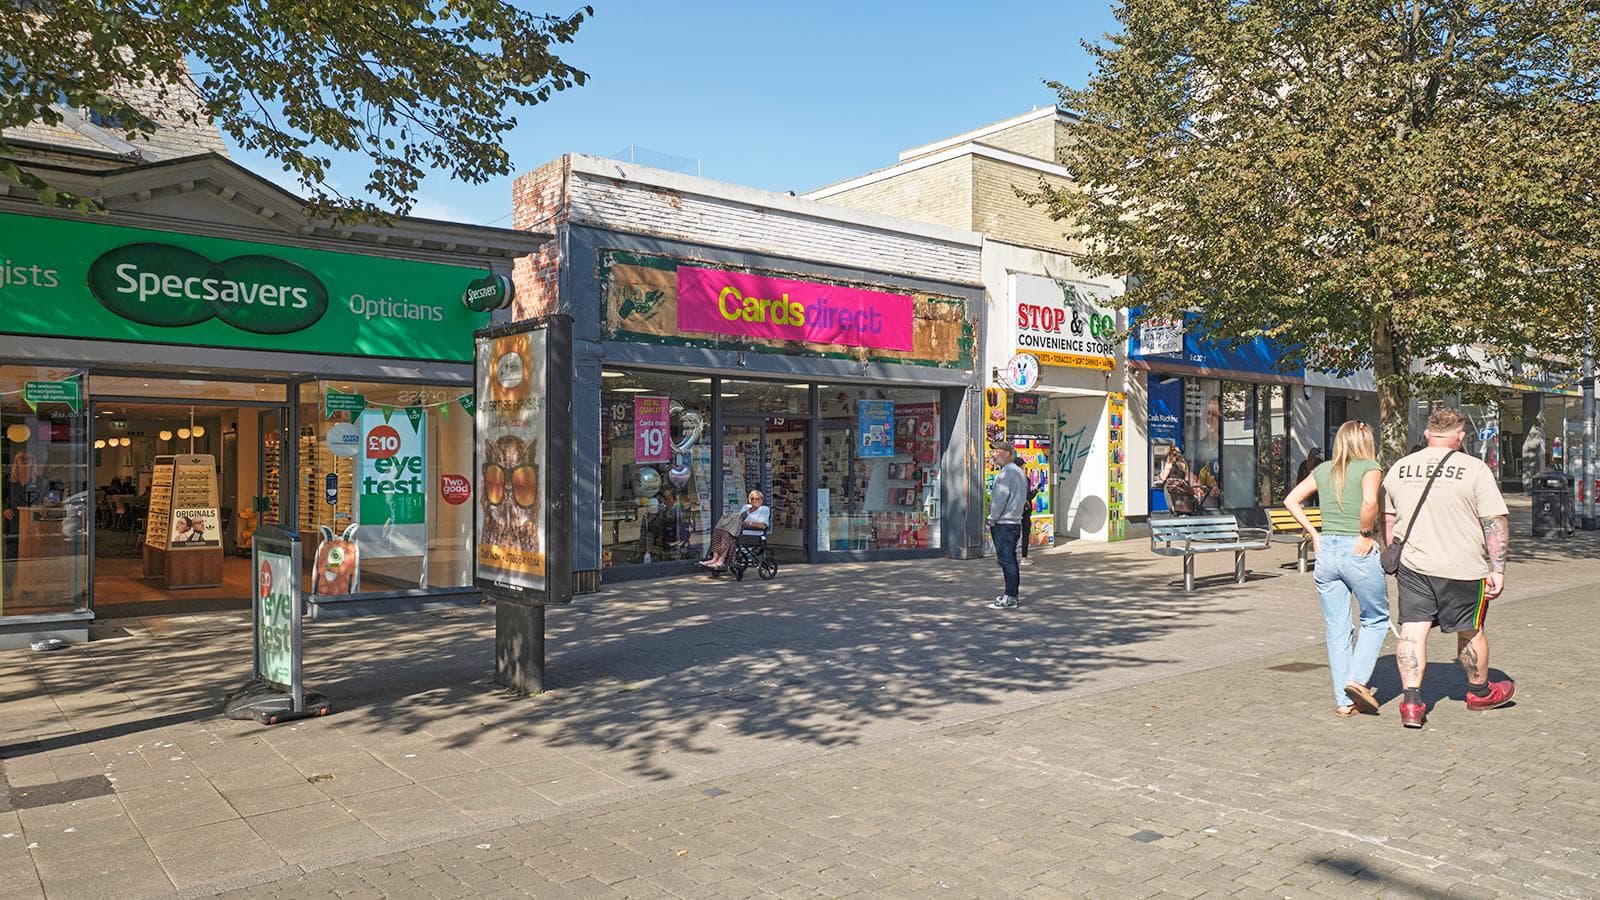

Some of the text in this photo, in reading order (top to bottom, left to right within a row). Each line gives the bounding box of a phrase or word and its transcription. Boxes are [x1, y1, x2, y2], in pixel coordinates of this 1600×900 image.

[115, 263, 308, 309] Specsavers
[467, 284, 497, 303] Specsavers
[349, 293, 443, 321] Opticians
[1018, 303, 1114, 340] STOP & GO
[1018, 334, 1114, 355] CONVENIENCE STORE
[639, 406, 665, 415] QUALITY
[643, 399, 660, 407] REAL
[639, 419, 654, 427] Cards
[342, 434, 360, 443] NHS
[368, 435, 398, 451] £10
[375, 456, 422, 479] eye
[363, 476, 422, 495] test
[443, 477, 463, 486] Two
[444, 484, 468, 495] good
[175, 509, 216, 518] ORIGINALS
[264, 593, 290, 625] eye
[260, 622, 290, 652] test
